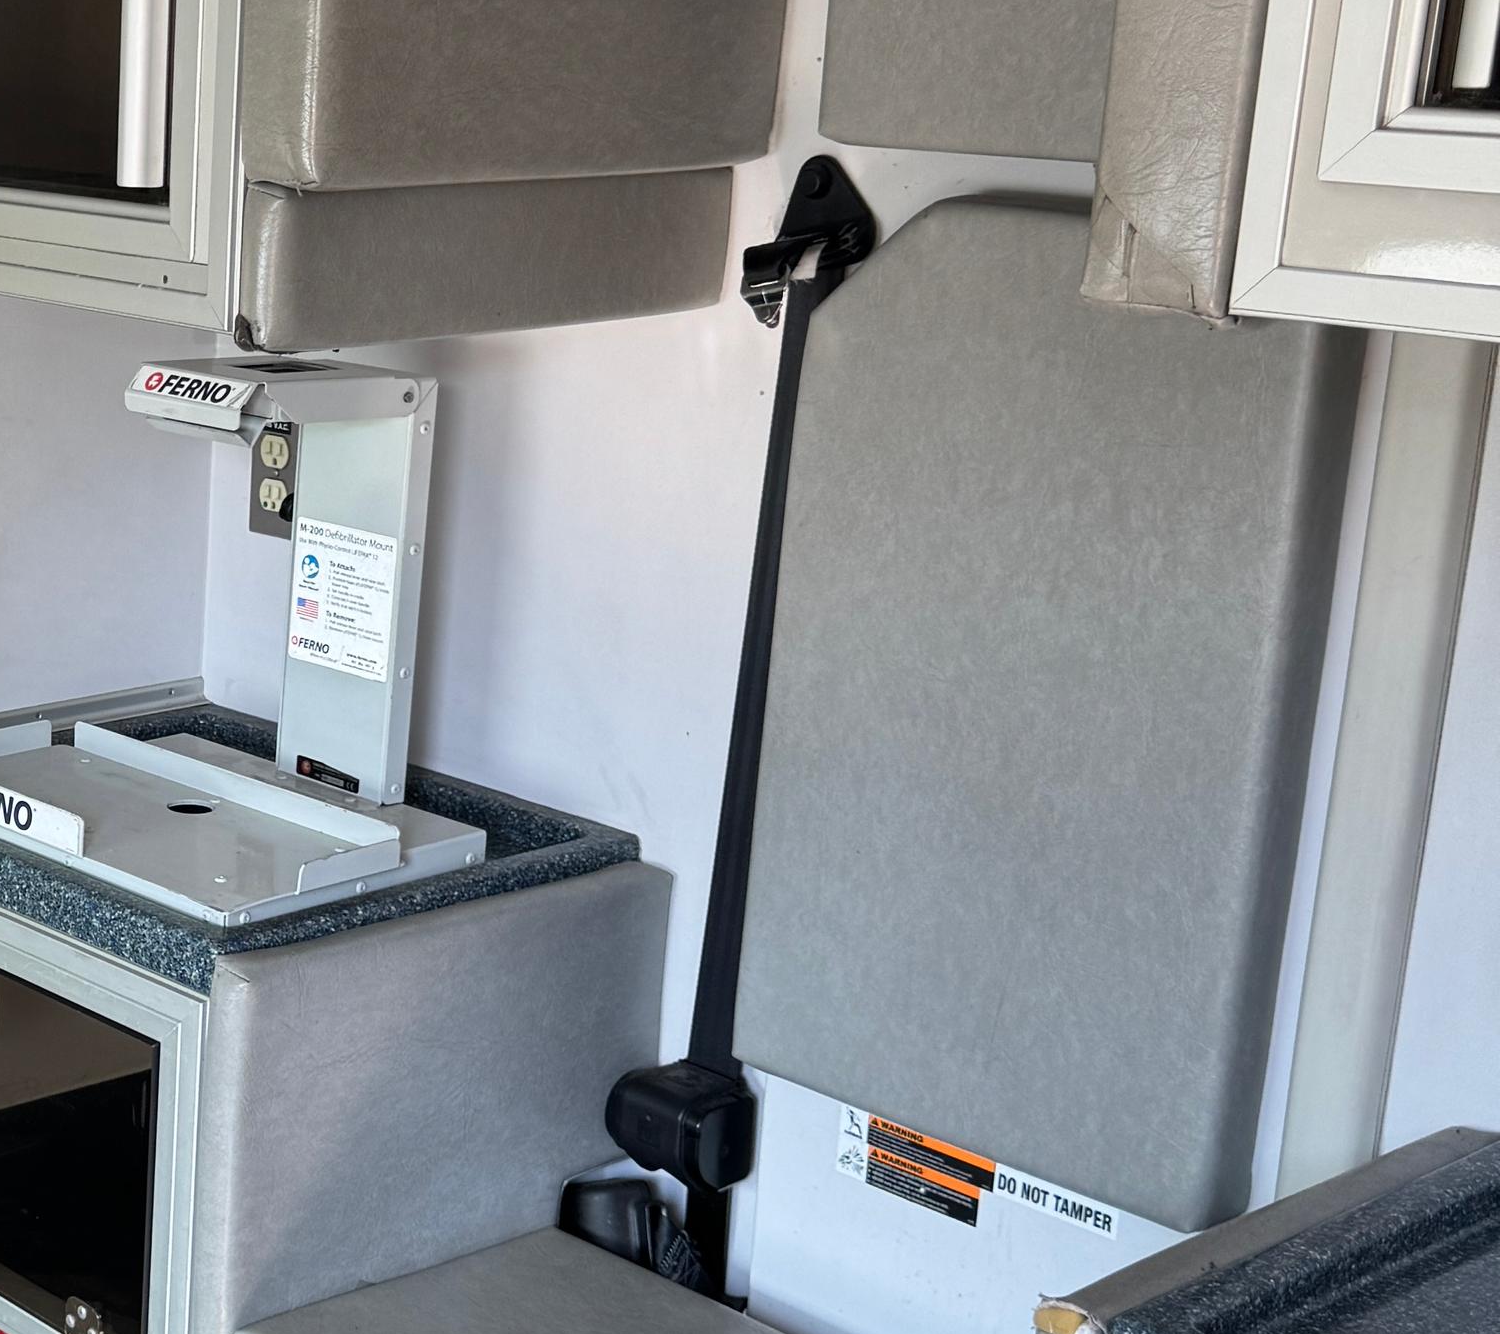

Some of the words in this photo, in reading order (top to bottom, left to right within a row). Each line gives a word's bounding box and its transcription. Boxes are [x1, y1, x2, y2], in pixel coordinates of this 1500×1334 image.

[157, 374, 232, 404] FERNO
[300, 522, 324, 536] M-200
[325, 528, 368, 547] Defibrillator
[369, 538, 394, 553] Mount
[298, 637, 330, 654] FERNO
[881, 1120, 924, 1143] WARNING
[881, 1151, 923, 1175] WARNING
[998, 1172, 1017, 1196] DO
[1021, 1181, 1048, 1208] NOT
[1053, 1194, 1112, 1233] TAMPER
